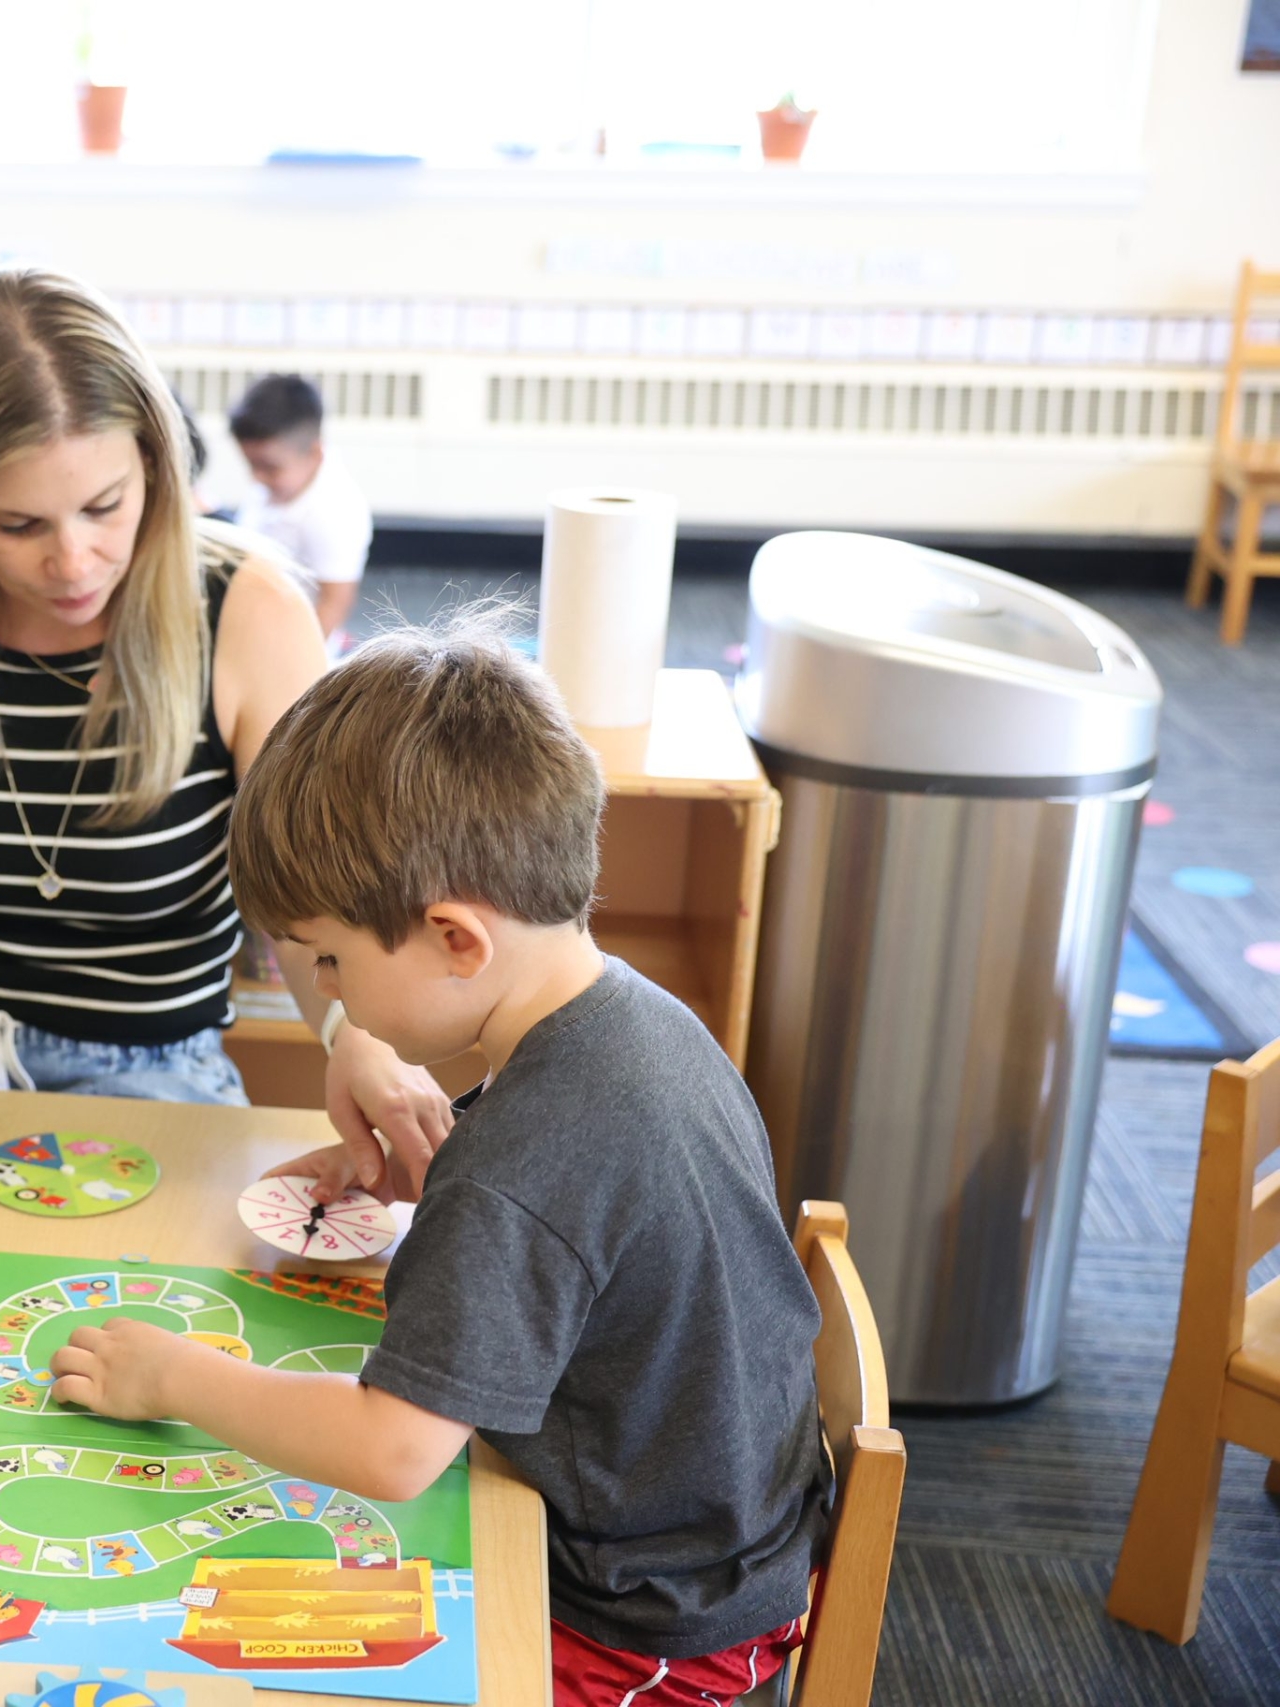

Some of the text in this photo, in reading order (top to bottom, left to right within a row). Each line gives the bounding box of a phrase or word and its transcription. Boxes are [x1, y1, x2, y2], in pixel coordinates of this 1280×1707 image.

[268, 1191, 287, 1203] 3
[340, 1195, 359, 1205] 5
[258, 1211, 282, 1220] 2
[278, 1226, 300, 1240] 1
[355, 1231, 374, 1242] 7
[322, 1235, 339, 1249] 8
[245, 1643, 287, 1655] COOP
